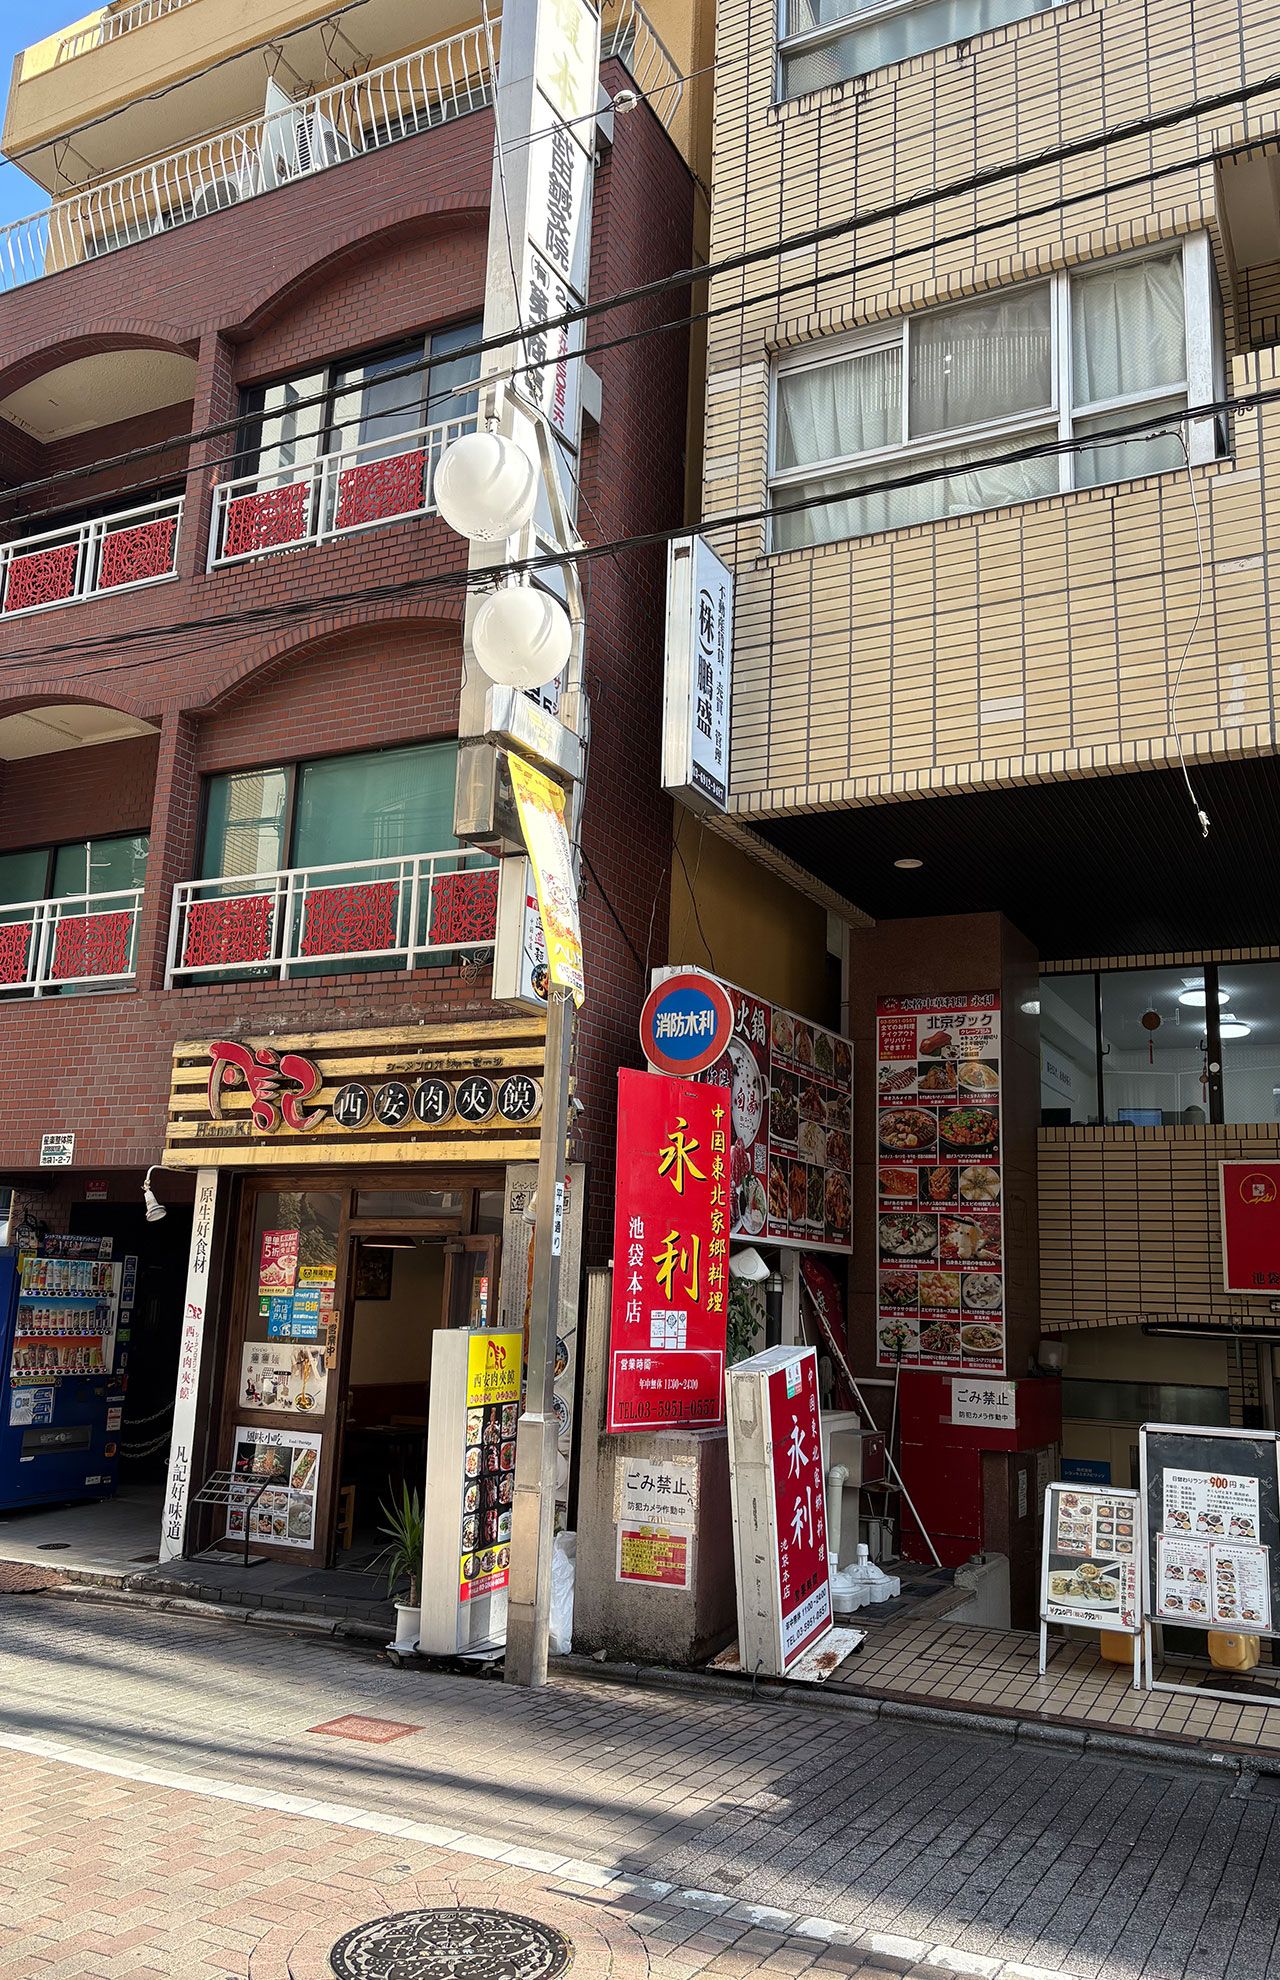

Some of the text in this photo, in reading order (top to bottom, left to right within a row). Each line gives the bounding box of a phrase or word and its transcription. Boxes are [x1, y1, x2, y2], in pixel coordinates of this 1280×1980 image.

[545, 120, 575, 272] 武田鍼灸院
[901, 993, 995, 1011] 本格中華料理 永利
[735, 1000, 766, 1047] 火鍋
[927, 1014, 992, 1029] 北京ダック
[652, 1116, 707, 1302] 永利
[706, 1104, 727, 1313] 中国東北家郷料理
[193, 1186, 214, 1274] 原生好食材
[625, 1217, 645, 1323] 池袋本店
[620, 1358, 652, 1370] 営業時間
[639, 1378, 662, 1390] 年中無休
[957, 1388, 1010, 1406] ごみ禁止
[958, 1411, 1008, 1421] 防犯カメラ作動中
[627, 1472, 688, 1495] ごみ禁止
[787, 1415, 813, 1550] 永利
[1172, 1475, 1209, 1484] 日替わりランチ
[627, 1501, 685, 1515] 防犯カメラ作動中
